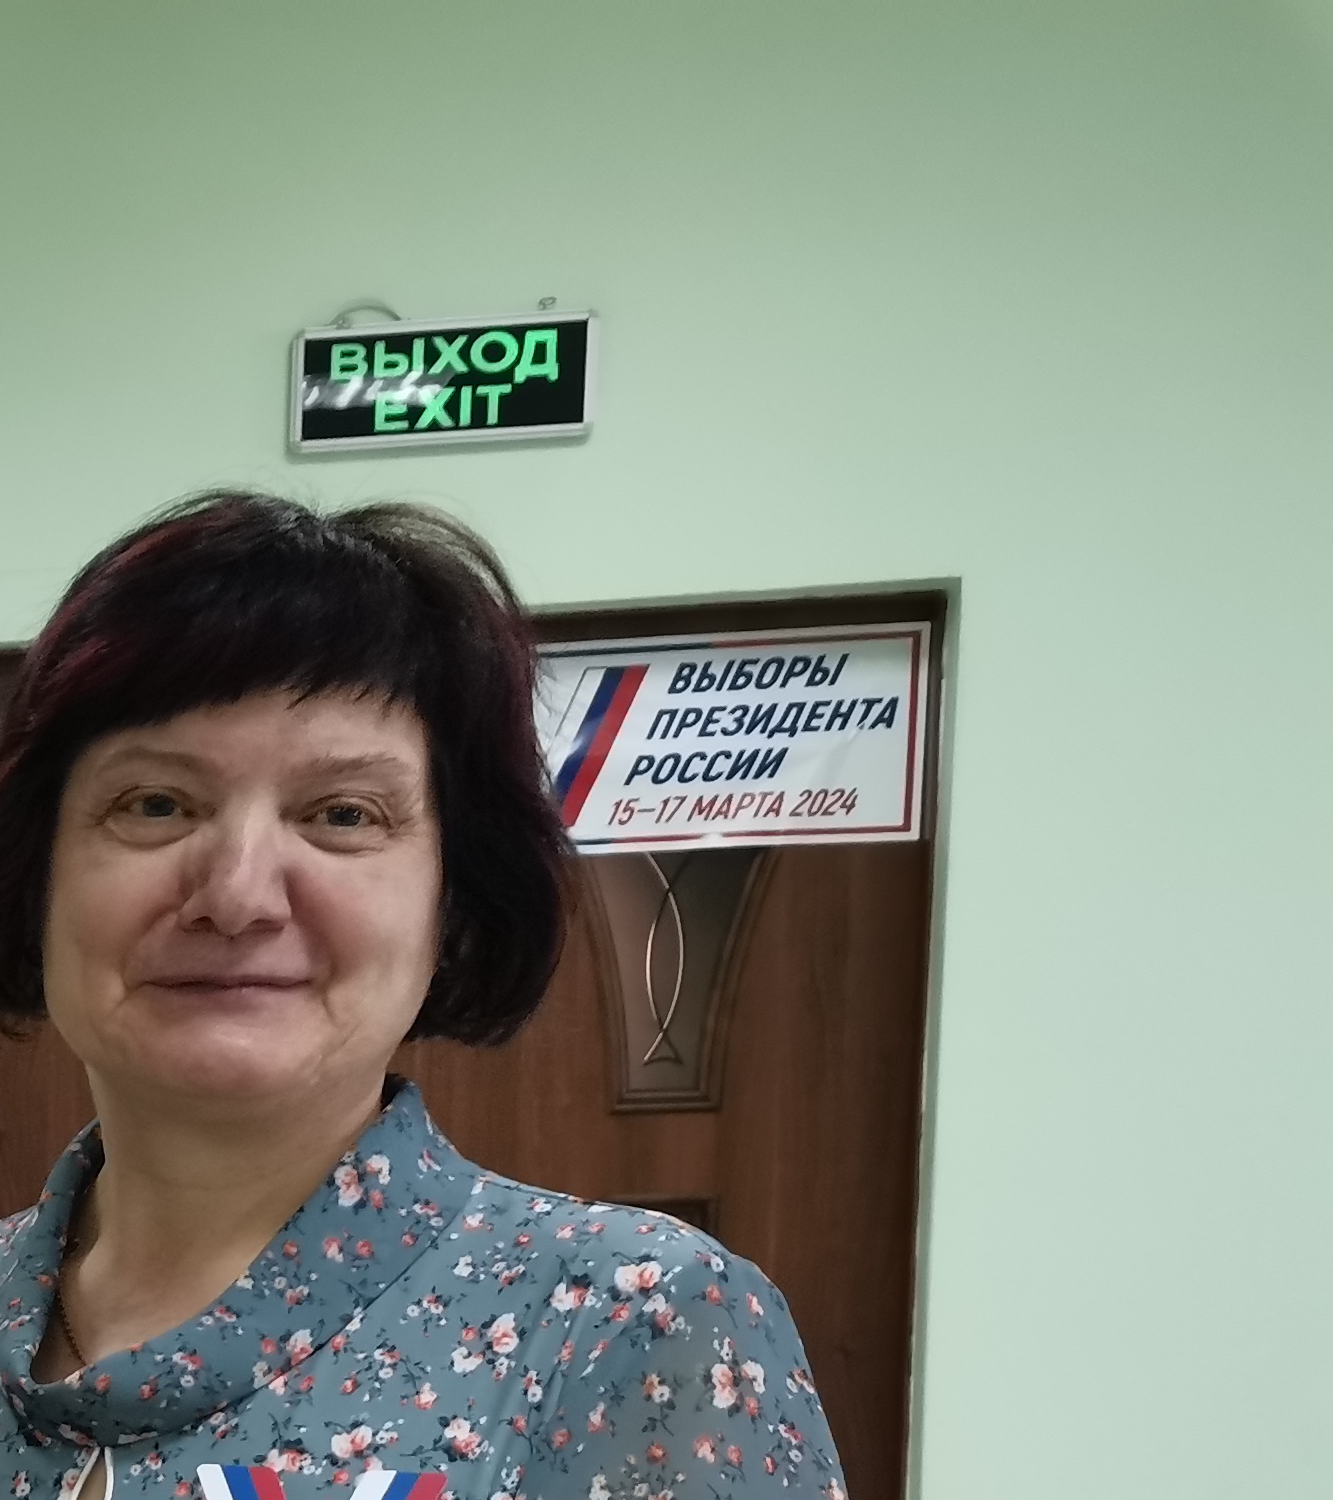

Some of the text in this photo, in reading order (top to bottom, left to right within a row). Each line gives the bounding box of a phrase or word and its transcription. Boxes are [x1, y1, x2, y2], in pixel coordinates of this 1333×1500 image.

[330, 327, 559, 386] ВЫХОД
[374, 383, 513, 432] EXIT
[668, 653, 850, 694] ВЫБОРЫ
[646, 696, 899, 740] ПРЕЗИДЕНТА
[623, 747, 790, 786] РОССИИ
[686, 791, 786, 823] МАРТА
[788, 787, 858, 818] 2024
